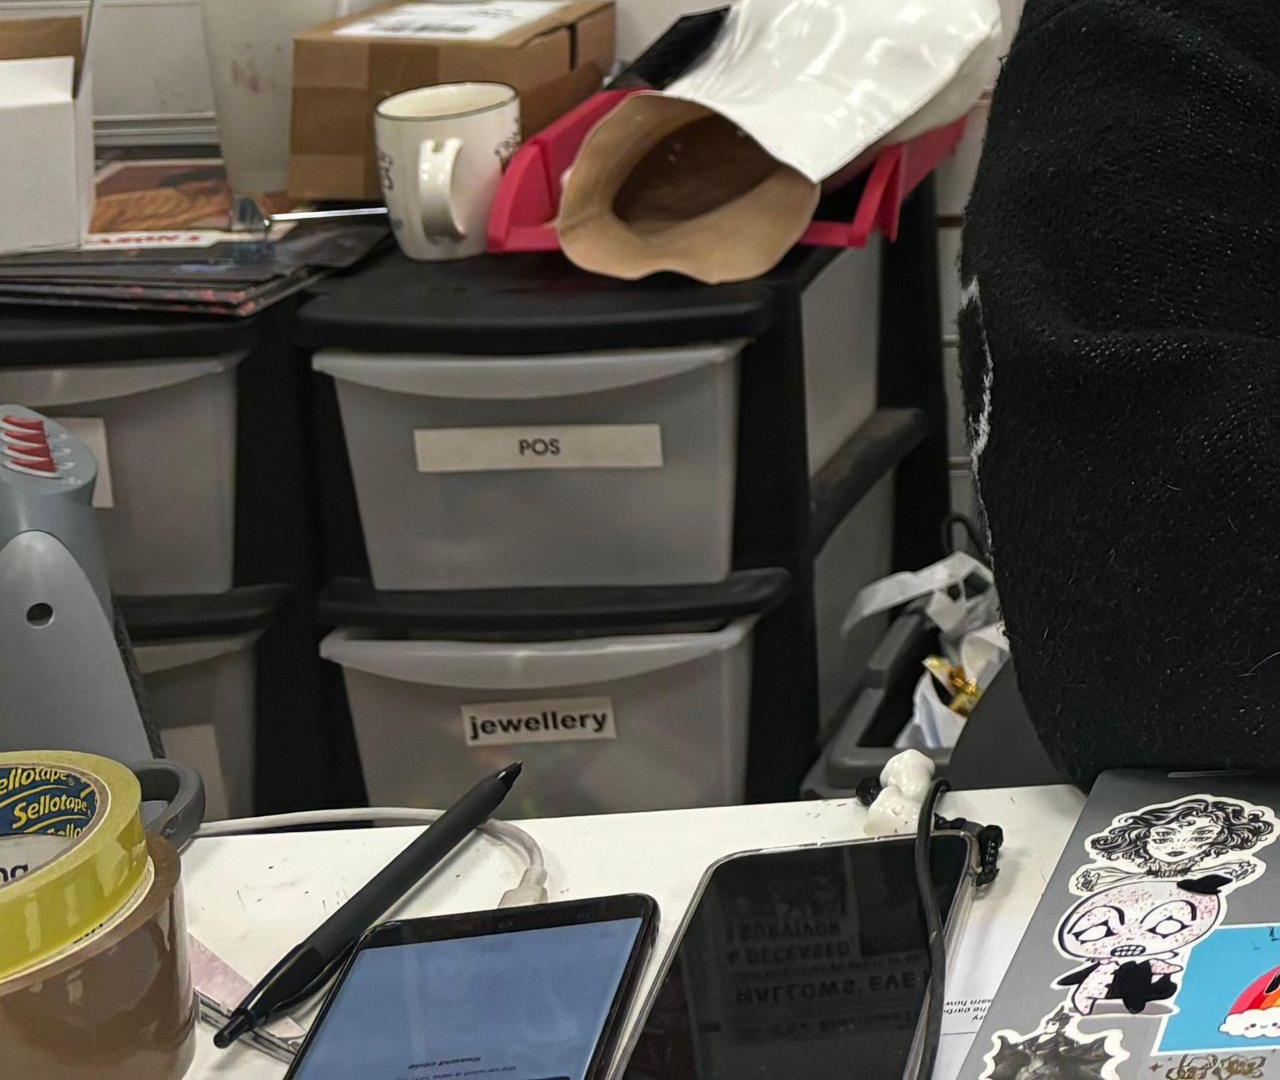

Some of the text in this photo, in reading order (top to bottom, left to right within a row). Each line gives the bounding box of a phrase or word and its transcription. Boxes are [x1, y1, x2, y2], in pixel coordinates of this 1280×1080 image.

[519, 439, 561, 455] POS
[470, 712, 608, 740] jewellery
[12, 794, 88, 829] Sellotape
